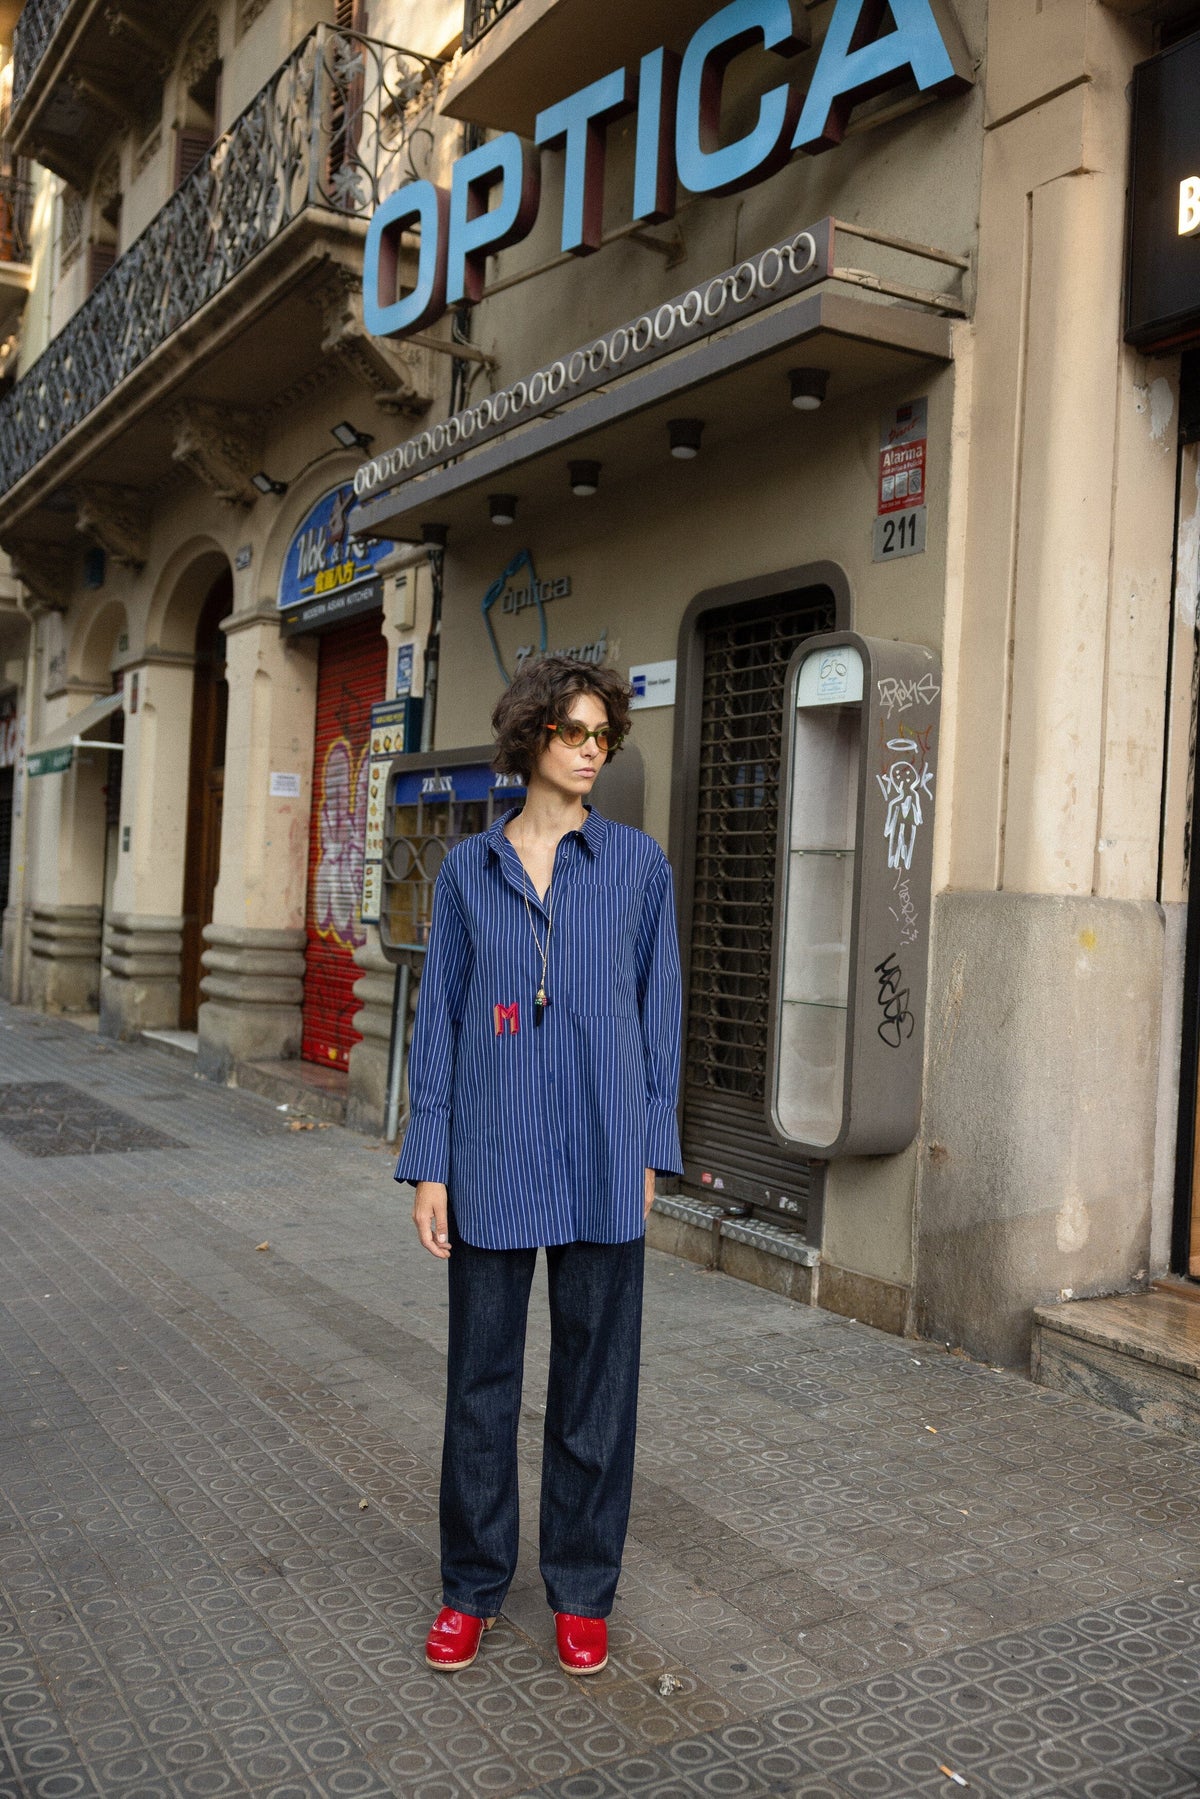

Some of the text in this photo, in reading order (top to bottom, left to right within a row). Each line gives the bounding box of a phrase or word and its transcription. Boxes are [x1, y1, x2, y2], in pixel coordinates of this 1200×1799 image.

[362, 0, 960, 338] OPTICA
[1178, 176, 1200, 235] B
[883, 446, 923, 467] Alarma
[297, 527, 326, 578] Wok
[883, 513, 916, 553] 211
[303, 588, 374, 620] MODERN ASIAN KITCHEN
[494, 1002, 519, 1036] M
